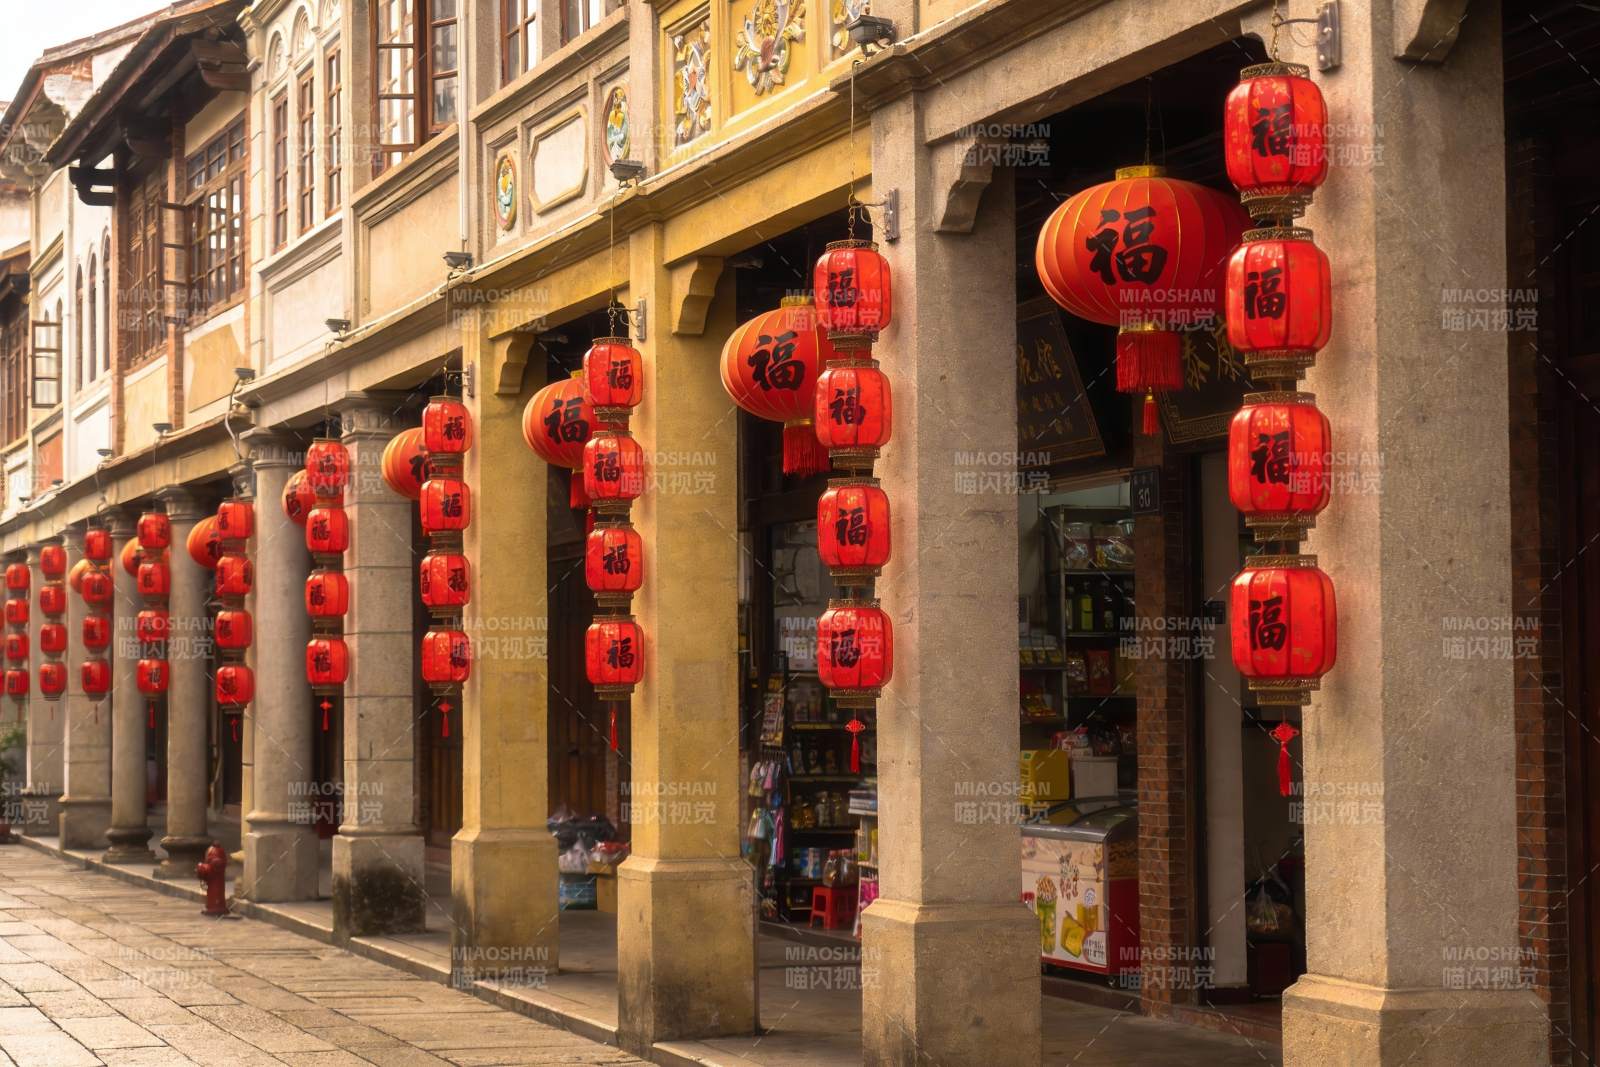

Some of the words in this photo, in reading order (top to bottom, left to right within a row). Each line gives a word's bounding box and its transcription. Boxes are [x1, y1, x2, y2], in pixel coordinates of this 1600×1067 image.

[1251, 106, 1293, 157] 福
[1086, 205, 1168, 285] 福
[828, 267, 858, 308] 福
[1245, 267, 1287, 320] 福
[607, 359, 634, 390] 福
[747, 330, 806, 391] 福
[544, 396, 590, 445] 福
[829, 385, 867, 425] 福
[443, 415, 466, 441] 福
[593, 452, 622, 482] 福
[1250, 433, 1291, 486] 福
[441, 493, 463, 518] 福
[836, 506, 871, 546] 福
[603, 543, 631, 575] 福
[448, 567, 468, 593] 福
[1249, 596, 1287, 651] 福
[606, 636, 634, 670] 福
